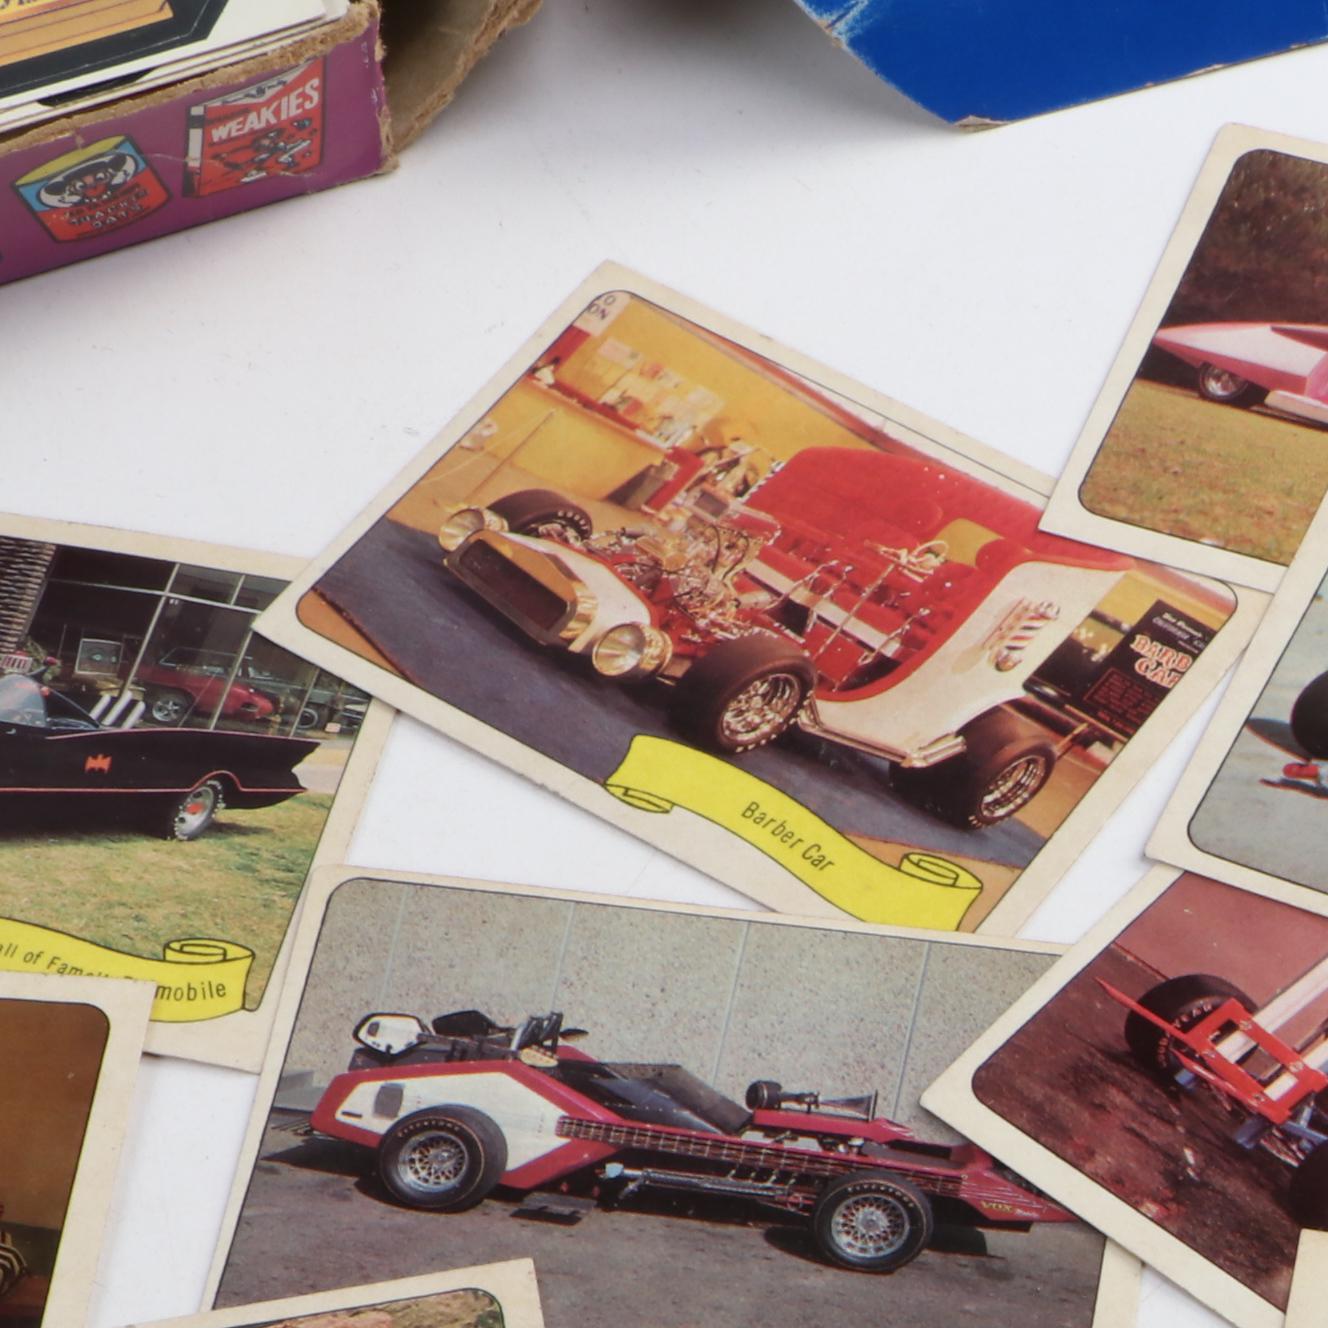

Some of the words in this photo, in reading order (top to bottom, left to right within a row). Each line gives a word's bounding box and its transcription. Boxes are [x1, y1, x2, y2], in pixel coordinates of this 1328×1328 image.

[211, 78, 321, 143] WEAKIES
[741, 801, 801, 850] Barber
[802, 842, 836, 872] Car
[23, 951, 44, 965] of
